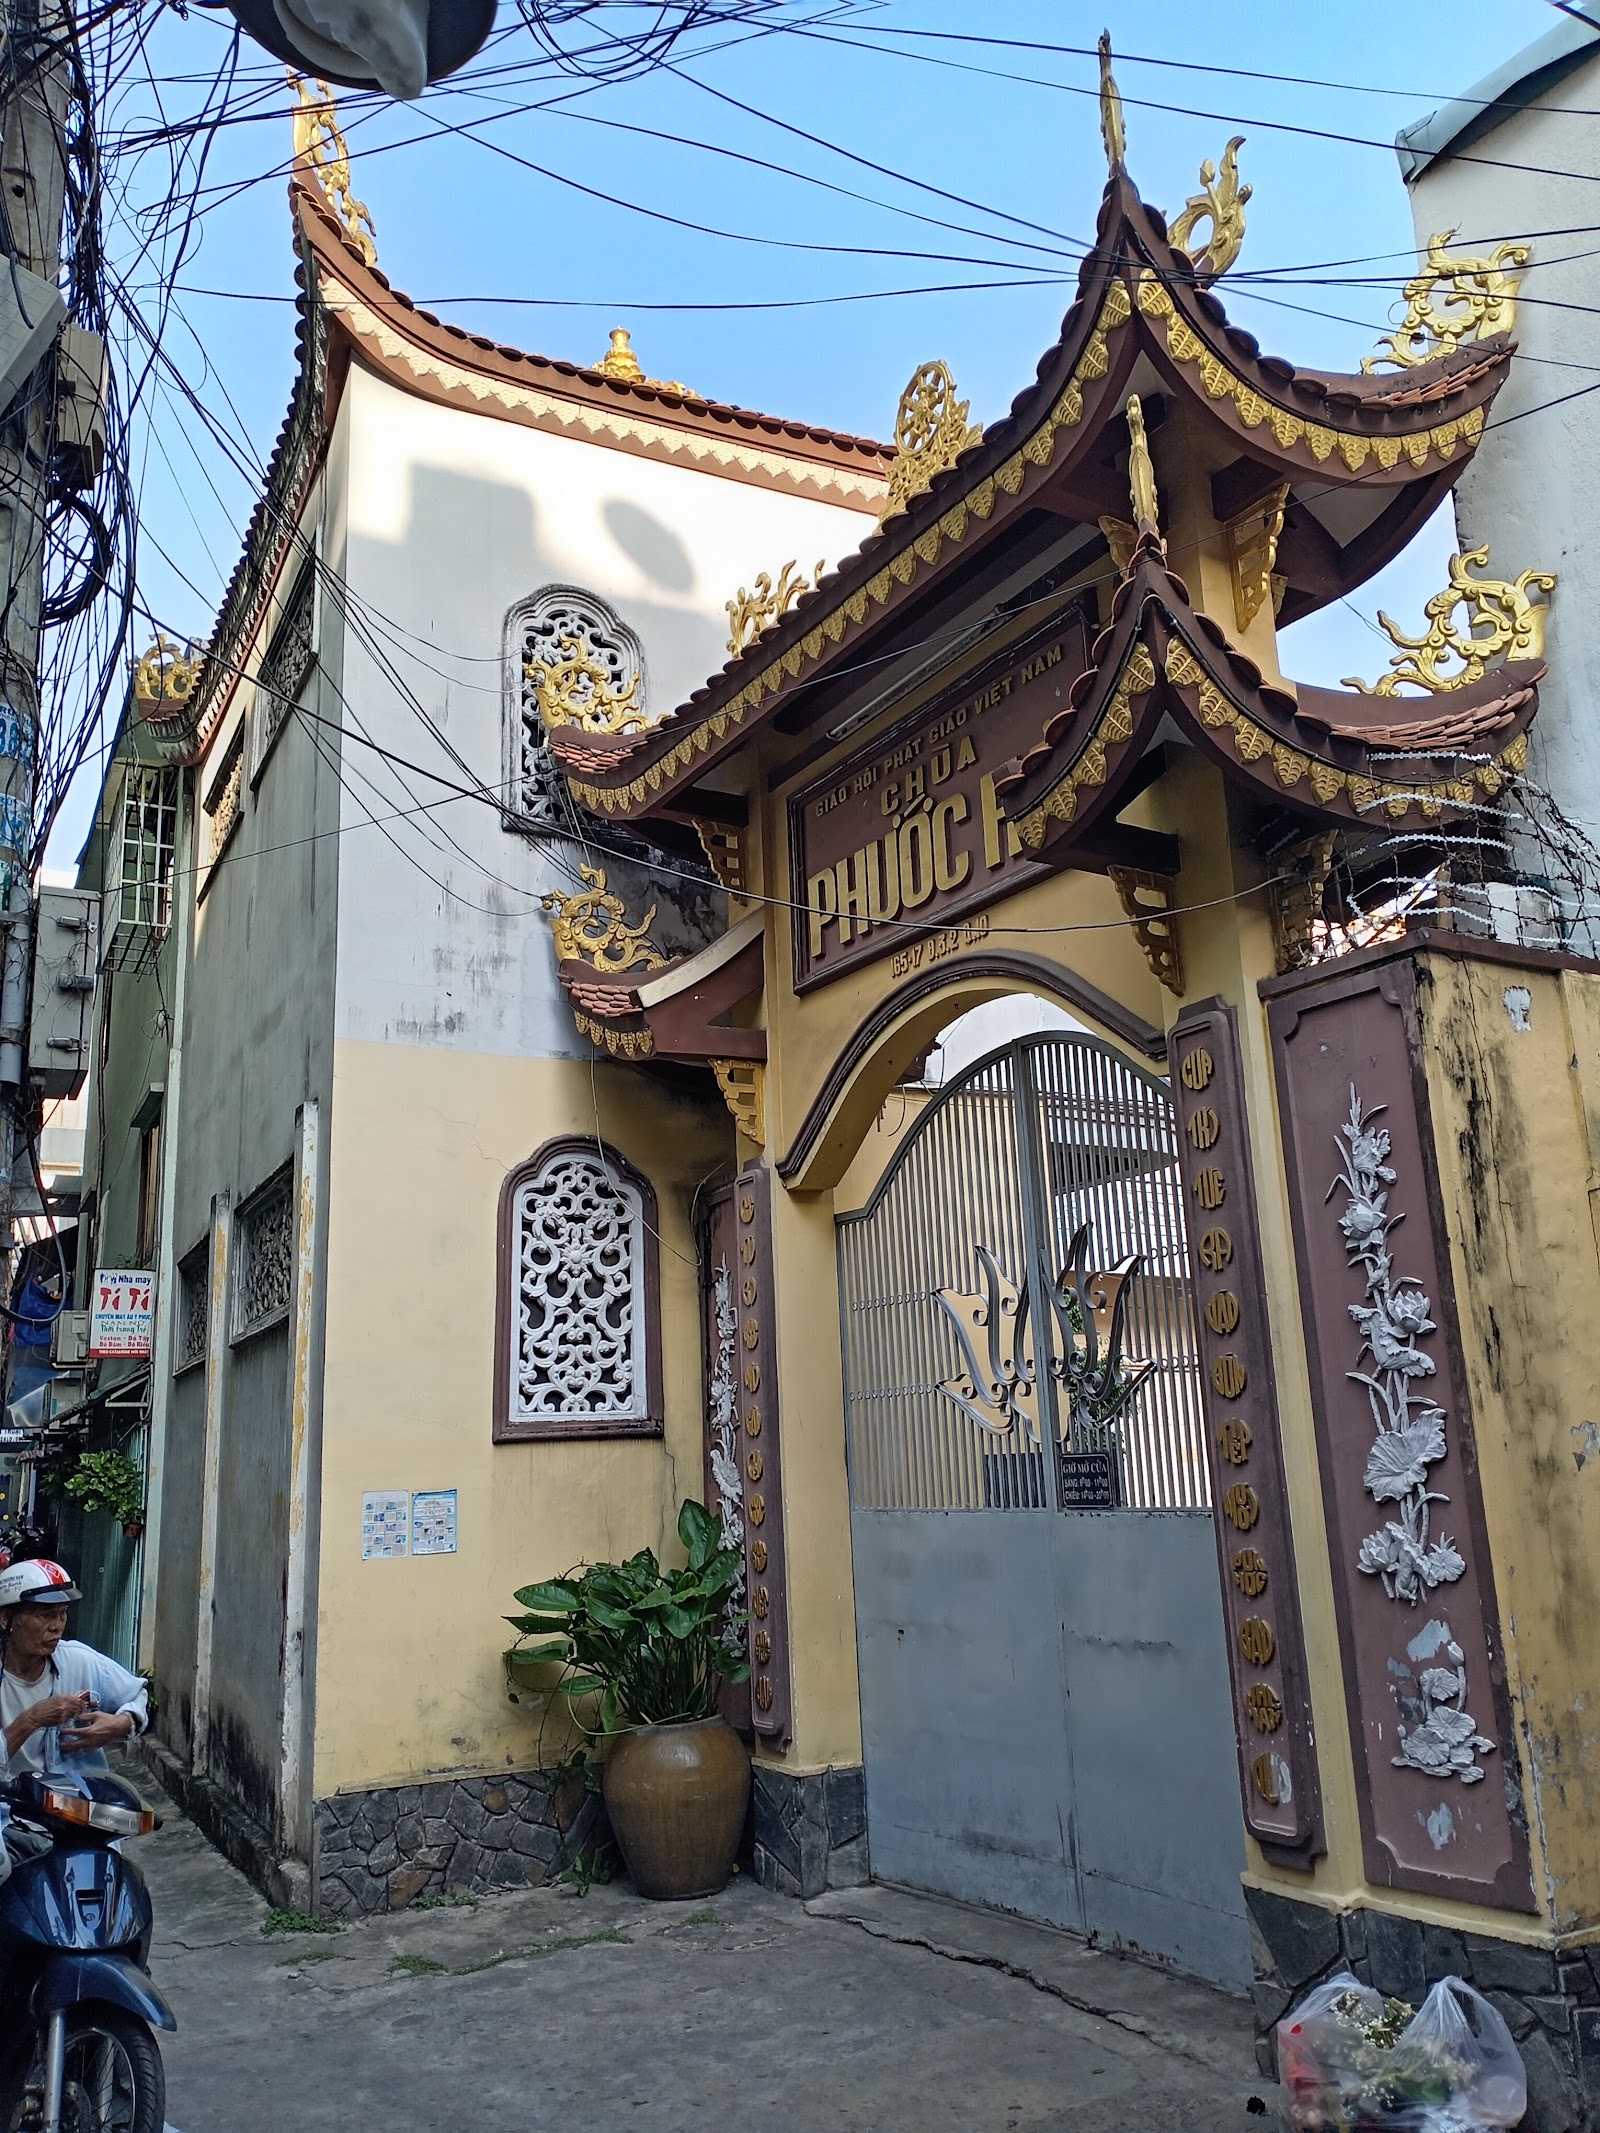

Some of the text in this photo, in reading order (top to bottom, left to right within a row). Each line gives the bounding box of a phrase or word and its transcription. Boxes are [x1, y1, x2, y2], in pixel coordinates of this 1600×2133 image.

[815, 644, 1062, 818] GIÁO HỘI PHẬT GIÁO VIỆT NAM
[881, 736, 977, 817] CHÙA
[807, 792, 970, 959] PHƯỚC
[135, 1276, 151, 1286] may
